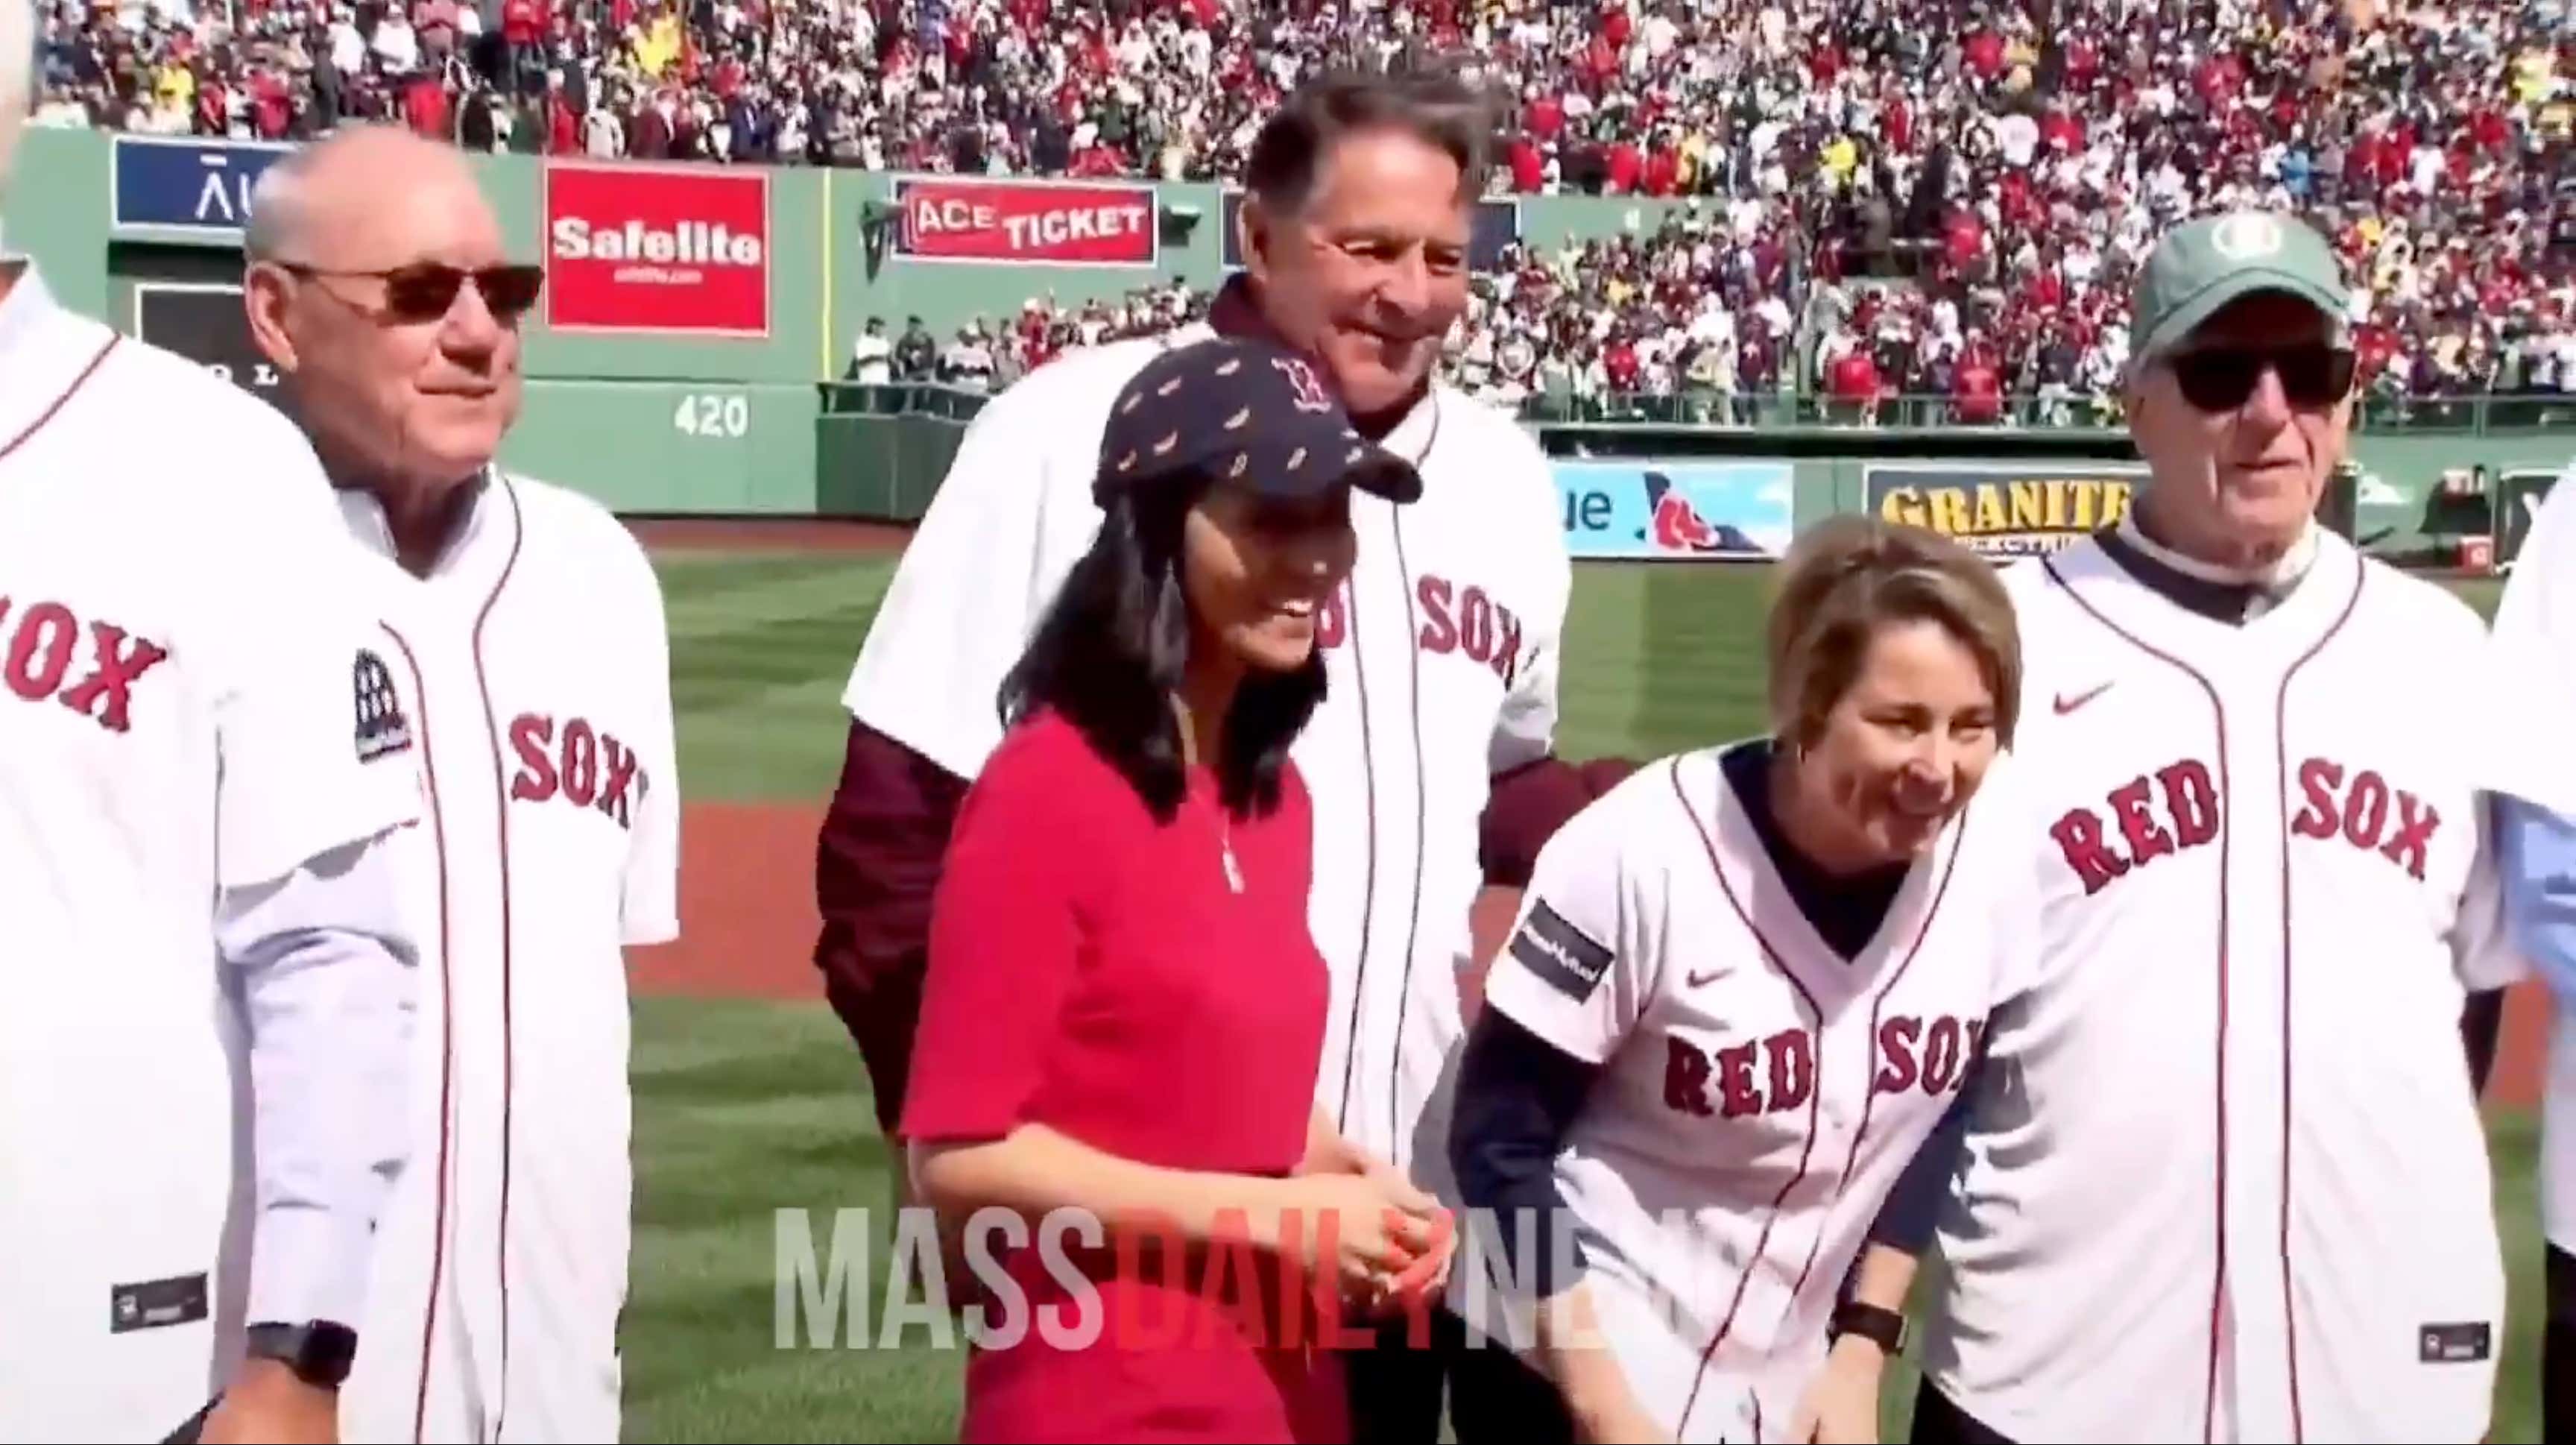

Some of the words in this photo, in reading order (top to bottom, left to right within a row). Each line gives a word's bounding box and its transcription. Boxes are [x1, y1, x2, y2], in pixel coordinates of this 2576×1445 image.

[552, 215, 761, 266] Safelite
[918, 198, 997, 234] ACE
[1001, 203, 1146, 251] TICKET
[674, 394, 748, 438] 420
[0, 594, 168, 734] OX
[1417, 573, 1522, 692] SOX
[508, 712, 649, 829] SOX
[2050, 758, 2220, 896] RED
[2291, 757, 2441, 882] SOX
[1662, 1027, 1814, 1120] RED
